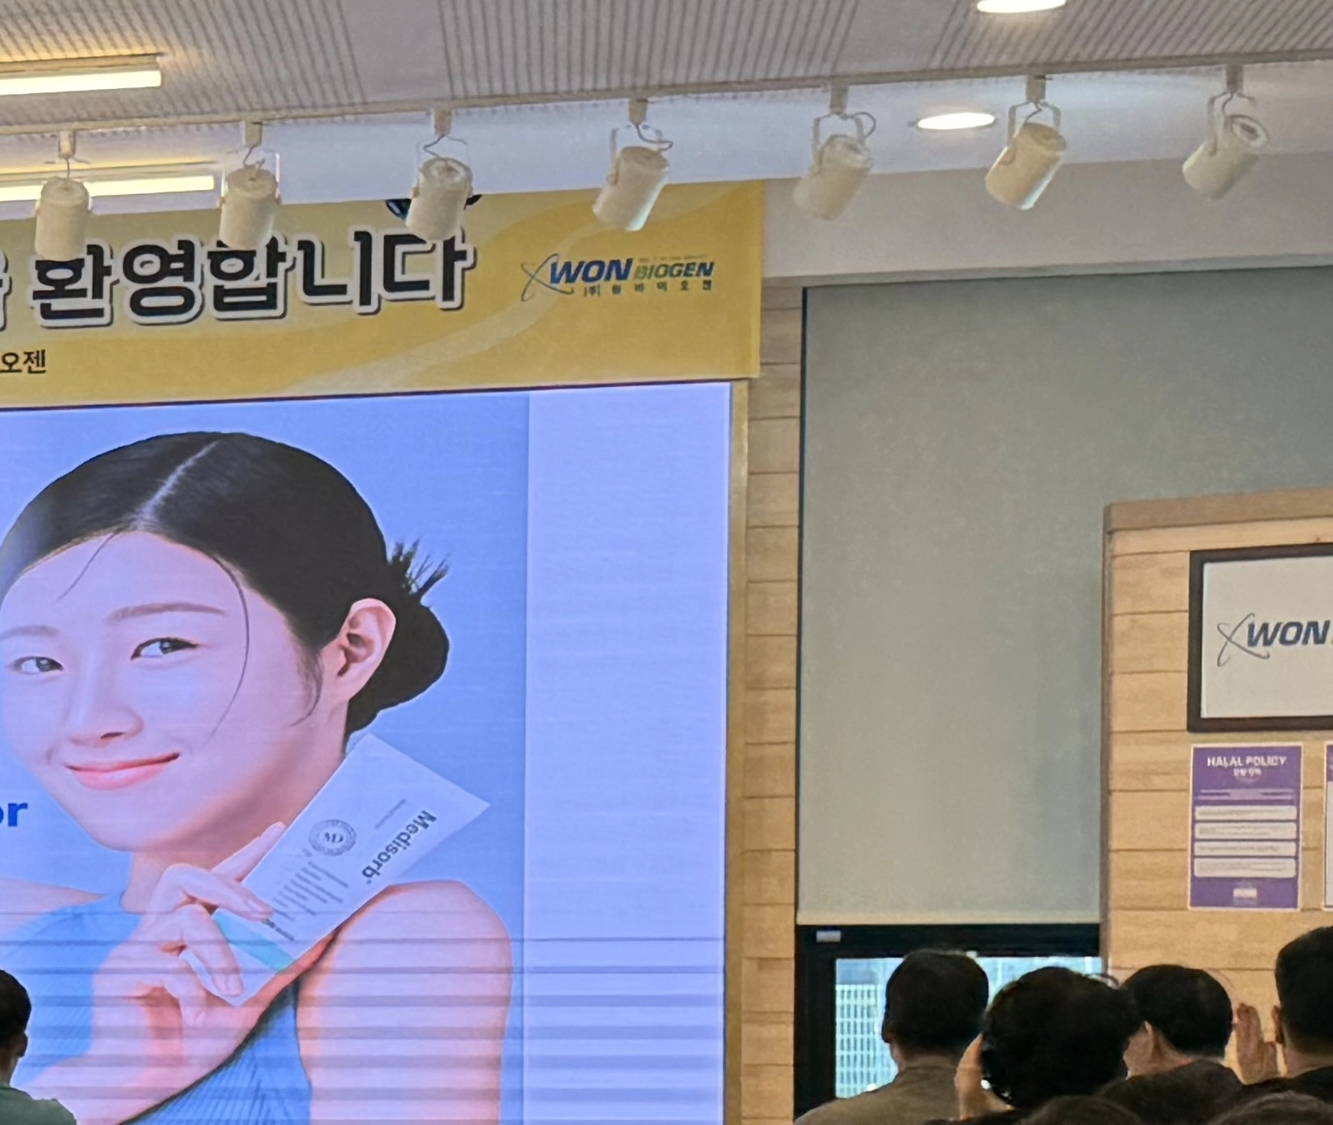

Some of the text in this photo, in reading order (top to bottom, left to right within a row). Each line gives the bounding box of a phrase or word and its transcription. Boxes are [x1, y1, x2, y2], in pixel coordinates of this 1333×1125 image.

[31, 230, 470, 322] 환영합니다
[549, 258, 715, 285] WON BIOGEN
[1247, 619, 1331, 648] WON
[1207, 757, 1243, 767] HALAL
[361, 809, 437, 885] Medisorb
